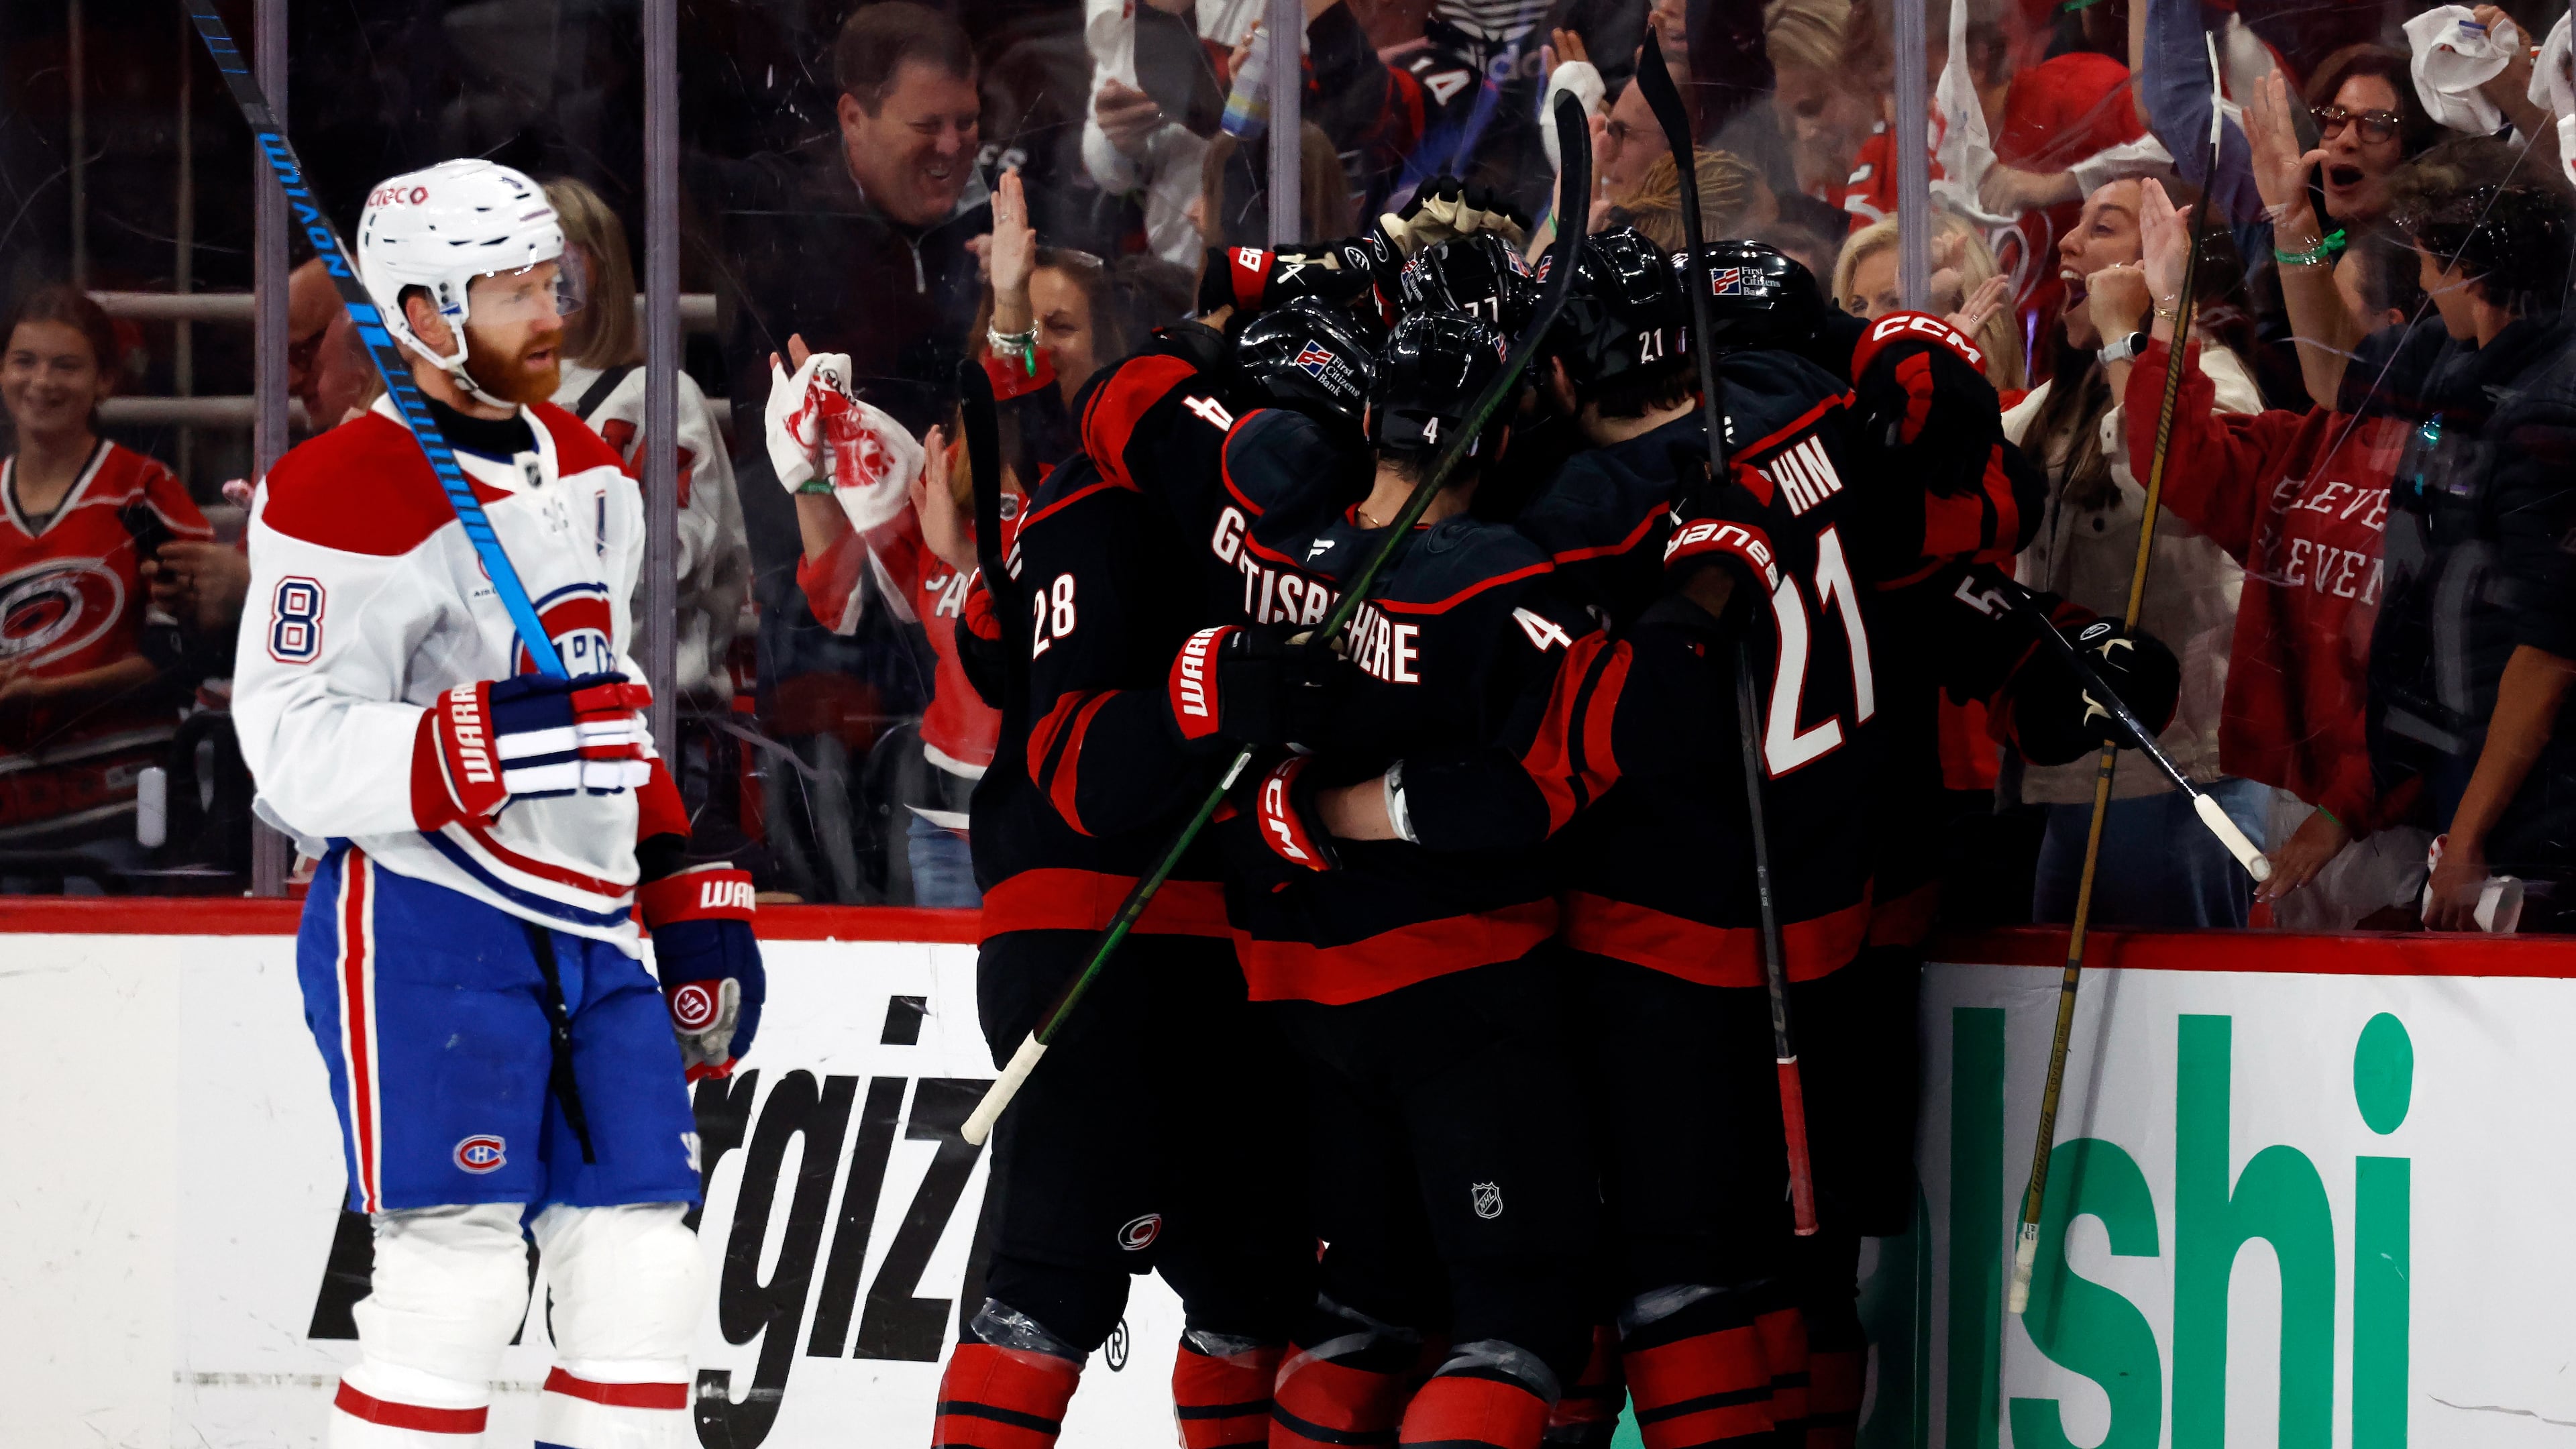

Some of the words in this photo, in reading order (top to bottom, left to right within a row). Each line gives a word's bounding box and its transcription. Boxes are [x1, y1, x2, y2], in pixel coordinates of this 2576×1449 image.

[1638, 327, 1664, 364] 21
[1872, 315, 1982, 364] CCM
[1326, 365, 1360, 396] Citizens
[1332, 354, 1354, 376] First
[1318, 373, 1341, 396] Bank
[1422, 417, 1438, 444] 4
[267, 575, 326, 664] 8
[1032, 572, 1075, 661] 28
[1512, 606, 1573, 653] 4
[1762, 522, 1876, 780] 21
[1479, 1191, 1495, 1212] NHL
